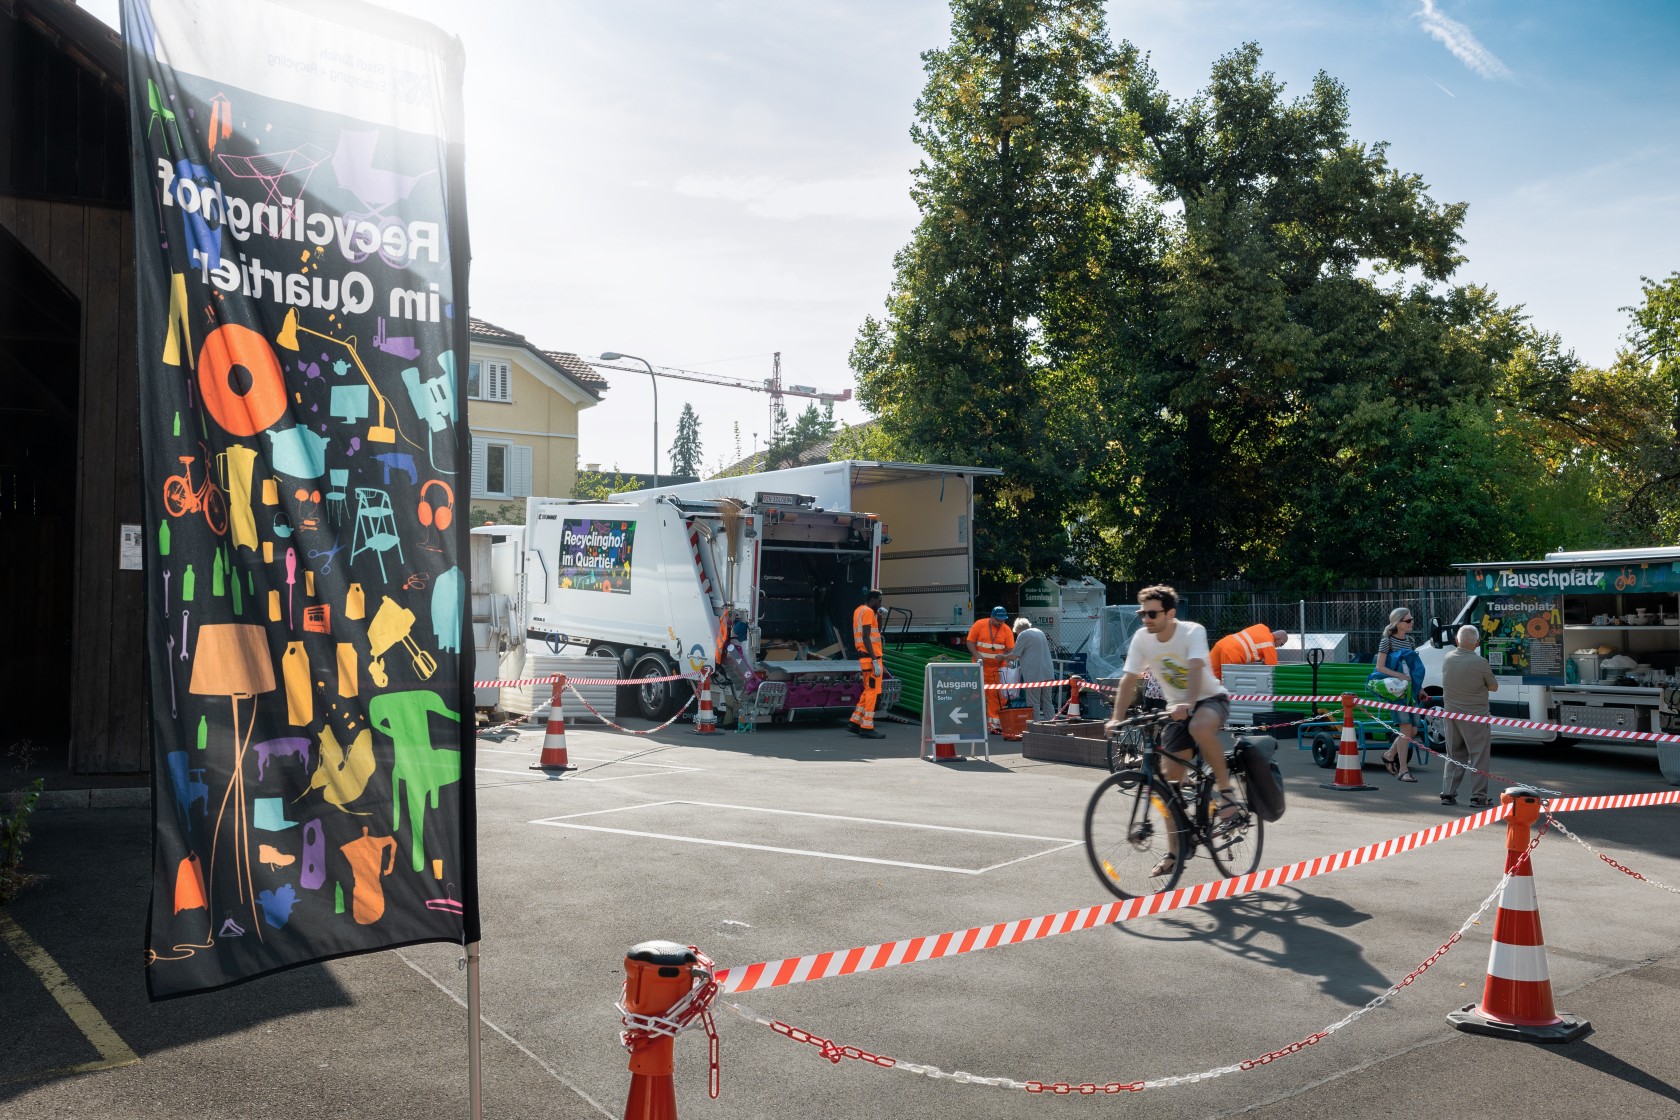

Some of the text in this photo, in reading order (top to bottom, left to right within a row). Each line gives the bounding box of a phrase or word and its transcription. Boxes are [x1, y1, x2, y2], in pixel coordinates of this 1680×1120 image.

[563, 530, 626, 550] Recyclinghof
[562, 551, 616, 569] im Quartier
[1500, 568, 1605, 590] Tauschplatz
[1025, 593, 1053, 603] Sammlung
[1486, 601, 1556, 612] Tauschplatz
[936, 679, 978, 690] Ausgang
